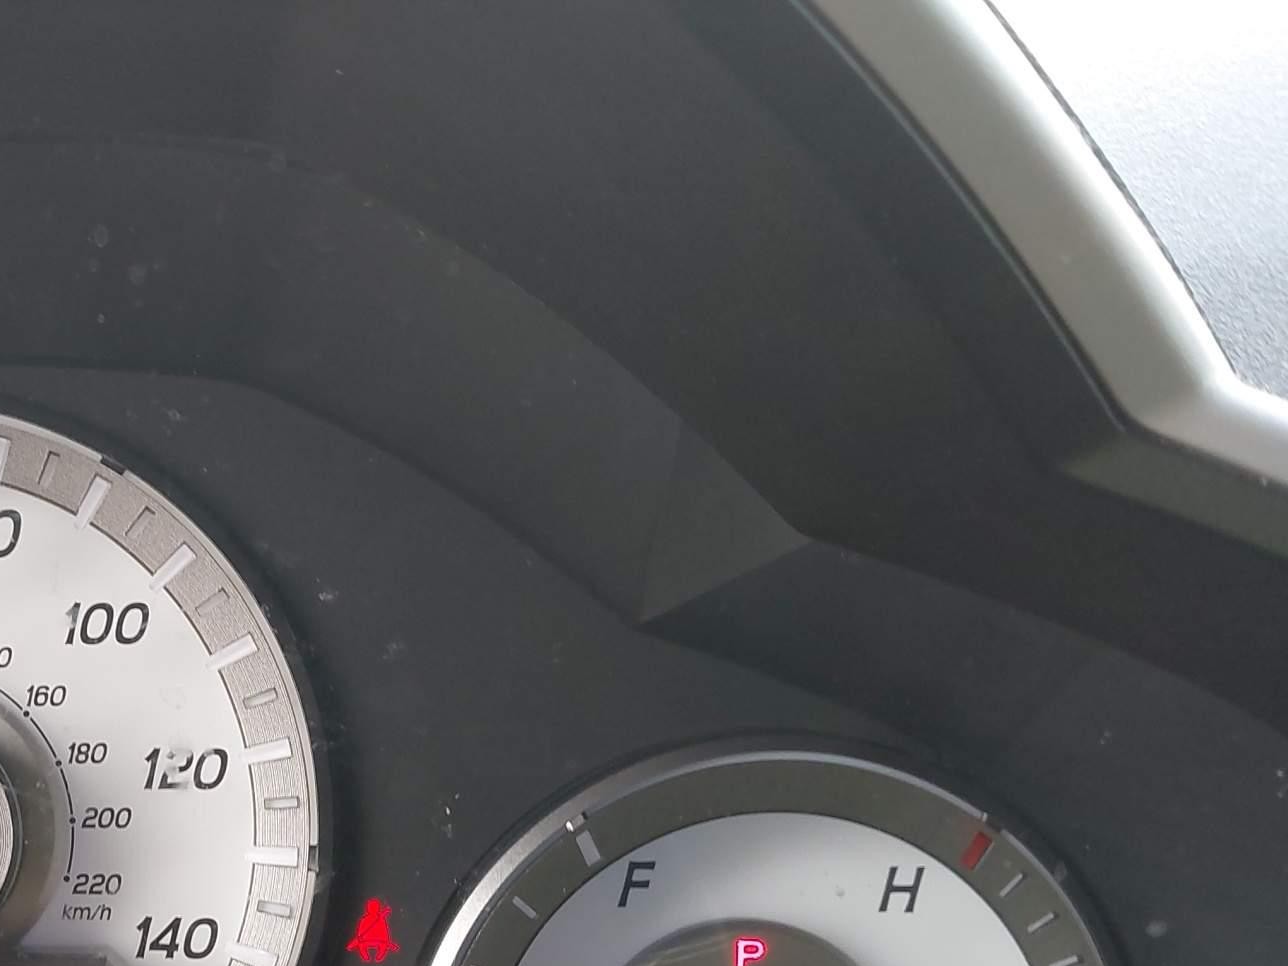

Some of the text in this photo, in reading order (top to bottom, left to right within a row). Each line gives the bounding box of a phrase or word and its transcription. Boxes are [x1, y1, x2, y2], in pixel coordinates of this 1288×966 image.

[64, 603, 149, 646] 100
[26, 685, 67, 707] 160
[67, 742, 108, 765] 180
[144, 747, 229, 789] 120
[81, 807, 132, 830] 200
[72, 873, 123, 896] 220
[618, 861, 656, 907] F
[879, 866, 925, 912] H
[62, 903, 112, 923] km/h
[135, 916, 218, 960] 140
